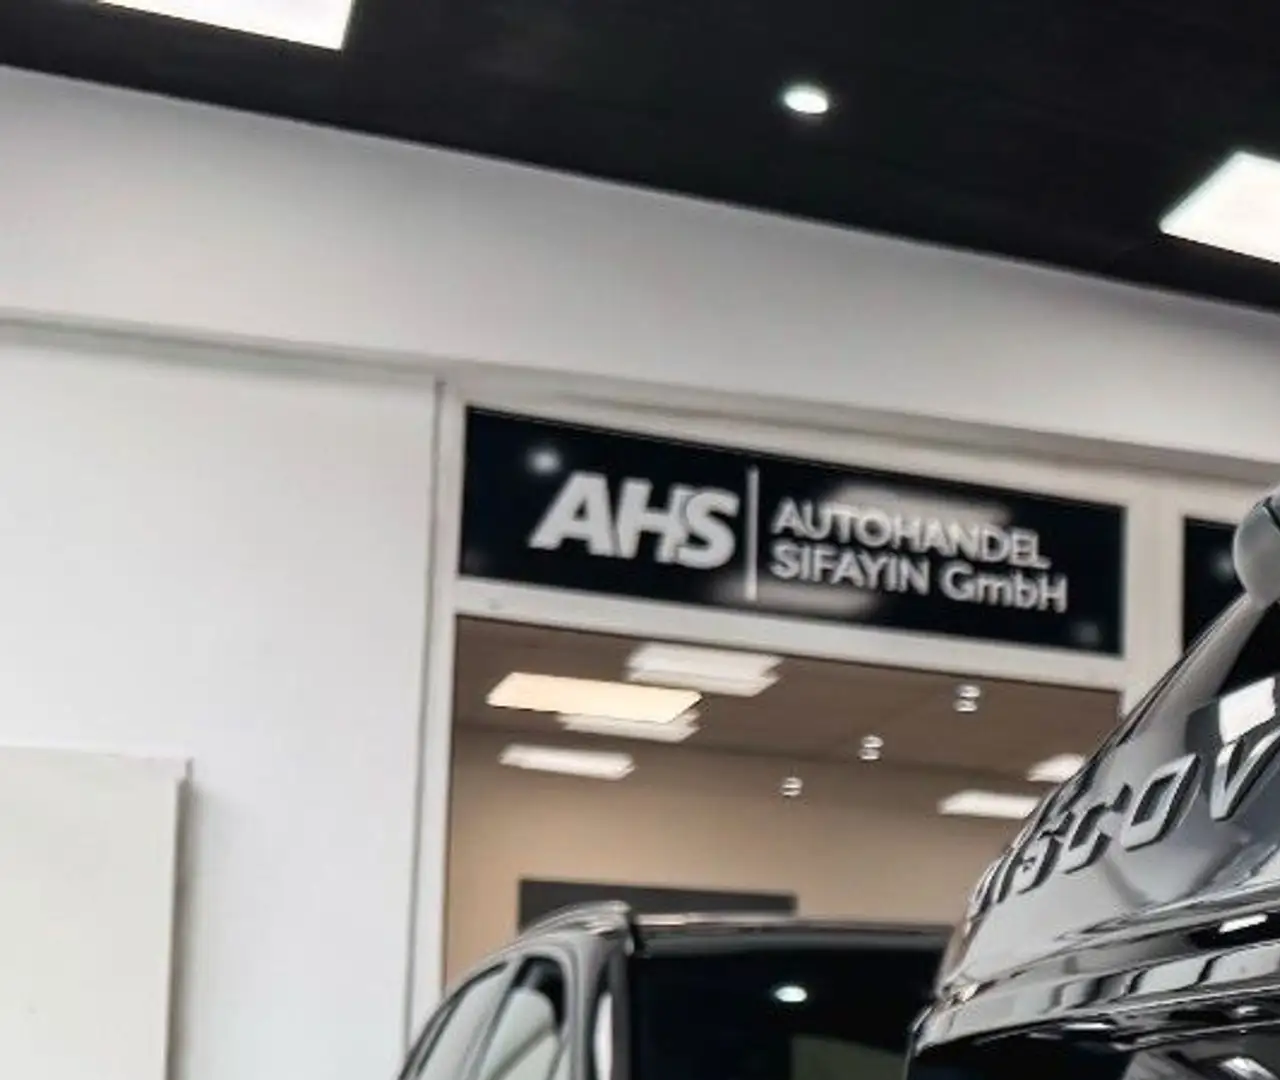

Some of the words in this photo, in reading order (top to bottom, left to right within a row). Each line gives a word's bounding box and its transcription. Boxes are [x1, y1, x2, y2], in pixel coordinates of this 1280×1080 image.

[528, 472, 739, 569] AHS
[773, 500, 1050, 570] AUTOHANDEL
[768, 543, 930, 595] SIFAYIN
[940, 567, 1068, 614] GmbH
